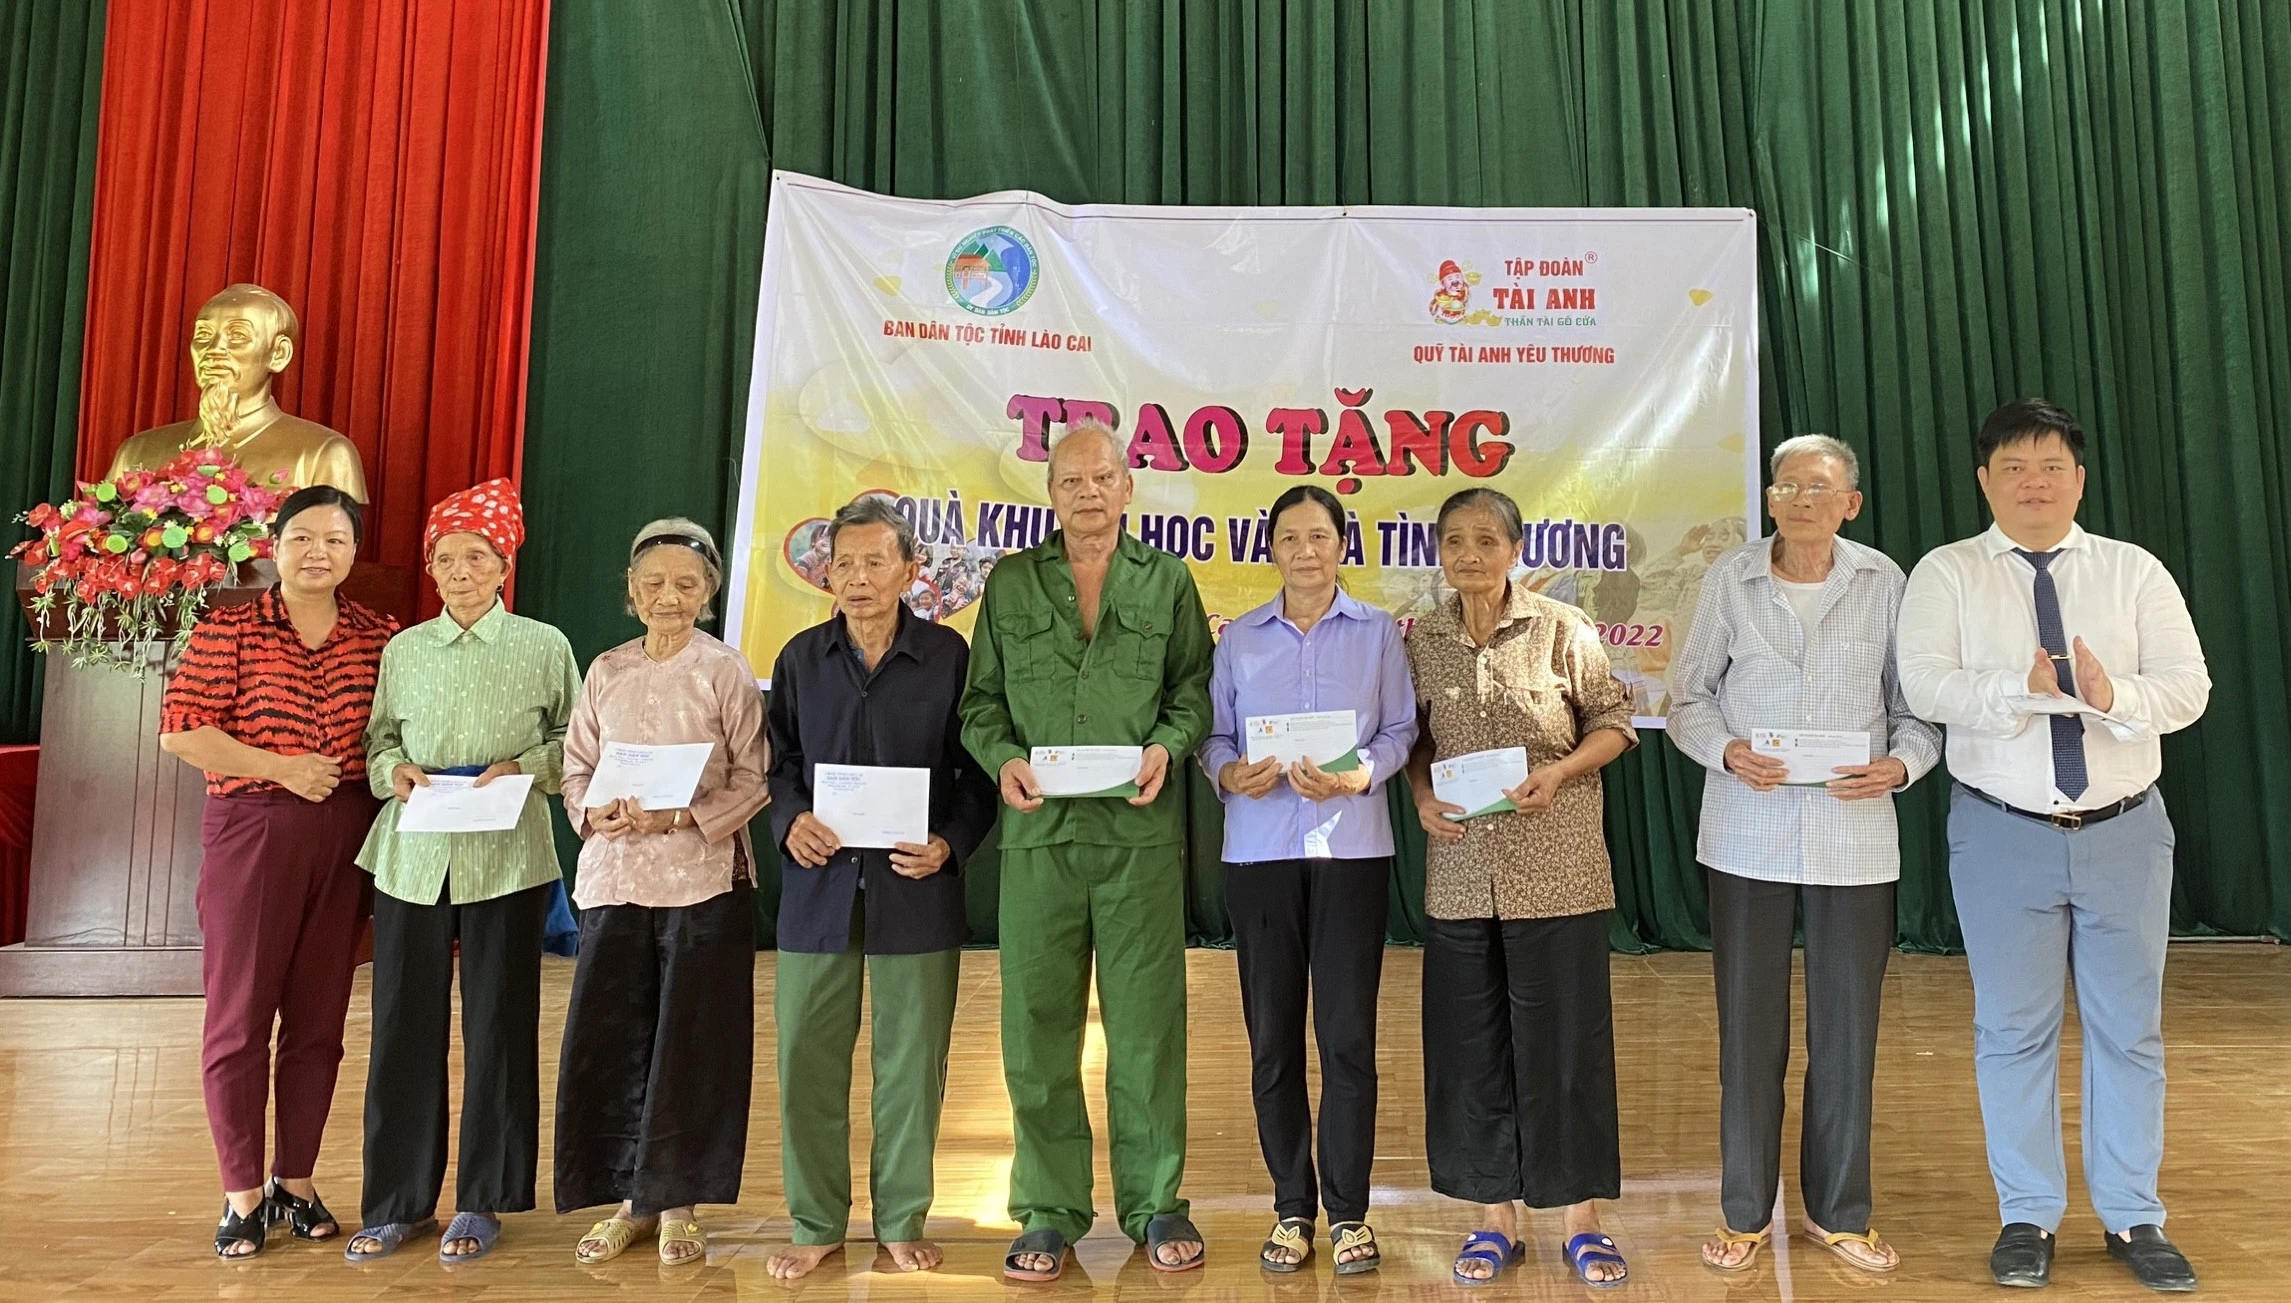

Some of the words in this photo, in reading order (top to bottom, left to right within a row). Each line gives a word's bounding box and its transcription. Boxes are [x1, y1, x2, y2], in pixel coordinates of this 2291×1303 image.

[1504, 257, 1534, 280] TẬP
[1539, 257, 1583, 276] ĐOÀN
[1493, 282, 1535, 309] TÀI
[1546, 288, 1596, 309] ANH
[883, 320, 915, 338] BAN
[919, 321, 950, 341] DÂN
[955, 323, 985, 346] TỘC
[990, 323, 1026, 347] TỈNH
[1031, 329, 1062, 350] LÀO
[1066, 335, 1092, 352] CAI
[1413, 343, 1444, 363] QUỸ
[1449, 343, 1473, 363] TÀI
[1478, 347, 1511, 363] ANH
[1516, 344, 1547, 363] YÊU
[1551, 345, 1615, 364] THƯƠNG
[1265, 387, 1516, 495] TẶNG
[1227, 509, 1273, 564] VÀ
[1376, 512, 1442, 568] TÌN
[1516, 518, 1628, 571] ƯƠNG
